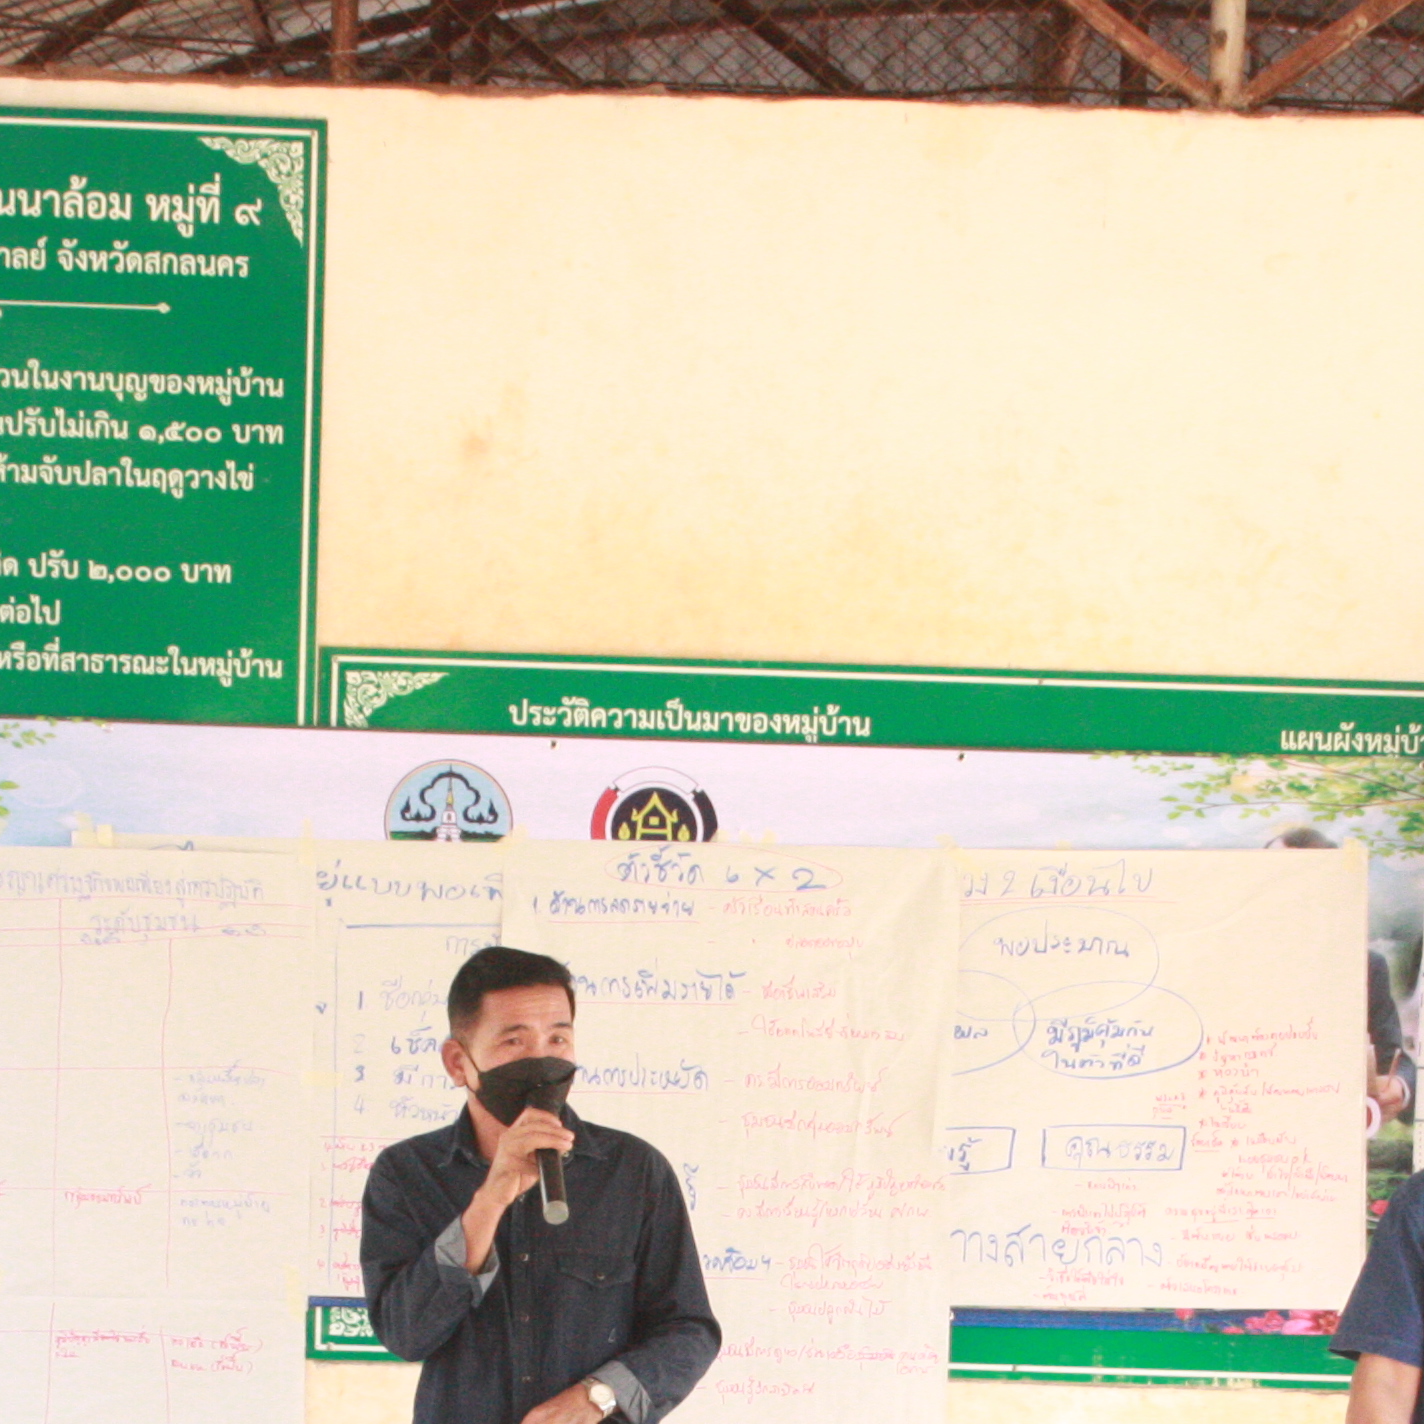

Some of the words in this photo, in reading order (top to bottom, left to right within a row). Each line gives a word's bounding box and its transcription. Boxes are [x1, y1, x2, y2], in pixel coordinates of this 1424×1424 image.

[145, 173, 220, 237] หมู่ที่
[234, 198, 262, 225] ๙
[57, 238, 249, 277] จังหวัดสกลนคร
[139, 421, 222, 443] ๑,๕๐๐
[232, 424, 283, 444] บาท
[28, 547, 79, 579] ปรับ
[88, 560, 171, 583] ๒,๐๐๐
[181, 563, 231, 583] บาท
[509, 697, 870, 744] ประวัติความเป็นมาของหมู่บ้าน
[993, 919, 1130, 958] พอประมาณ
